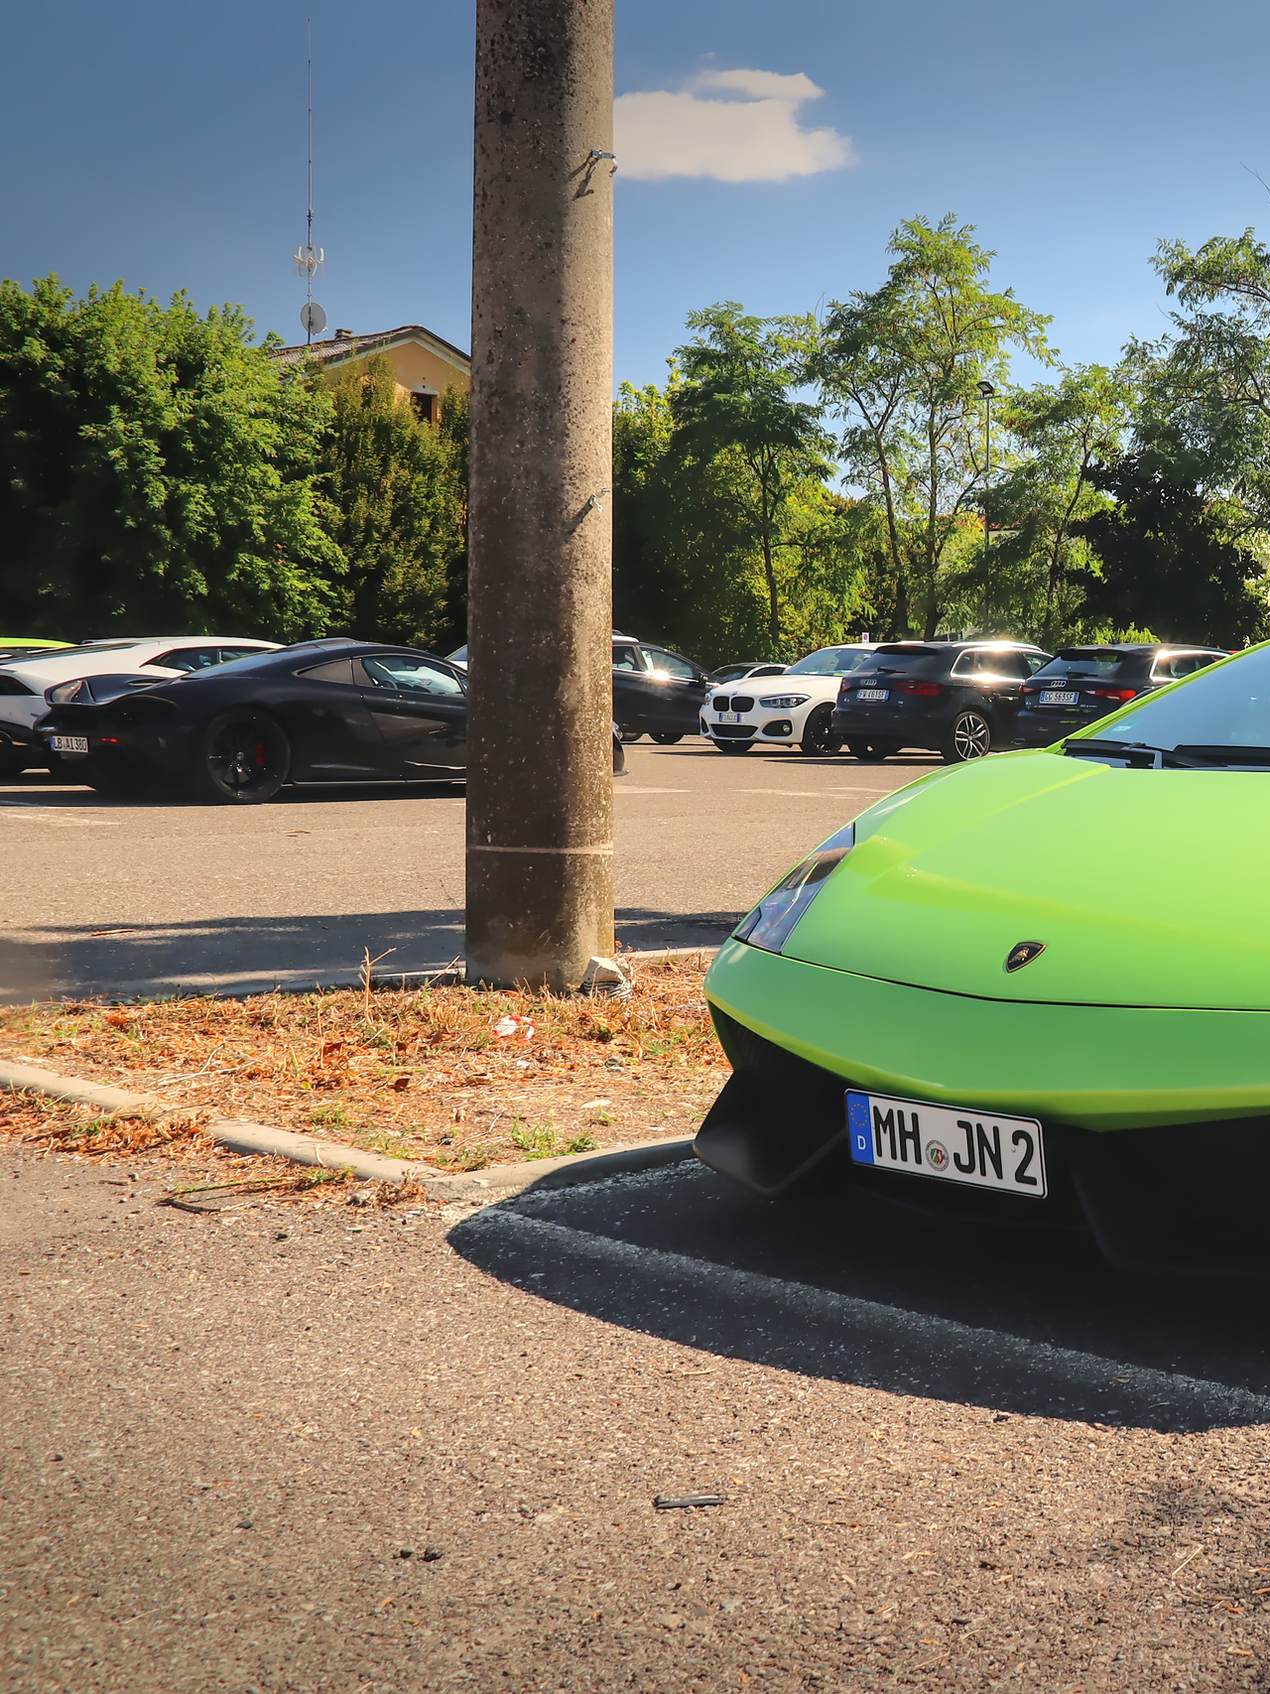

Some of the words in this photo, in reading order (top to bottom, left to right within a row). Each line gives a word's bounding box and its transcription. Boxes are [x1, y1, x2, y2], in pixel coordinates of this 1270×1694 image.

[857, 1135, 866, 1150] D
[873, 1105, 922, 1165] MH
[953, 1120, 1003, 1180] JN
[1012, 1130, 1037, 1186] 2
